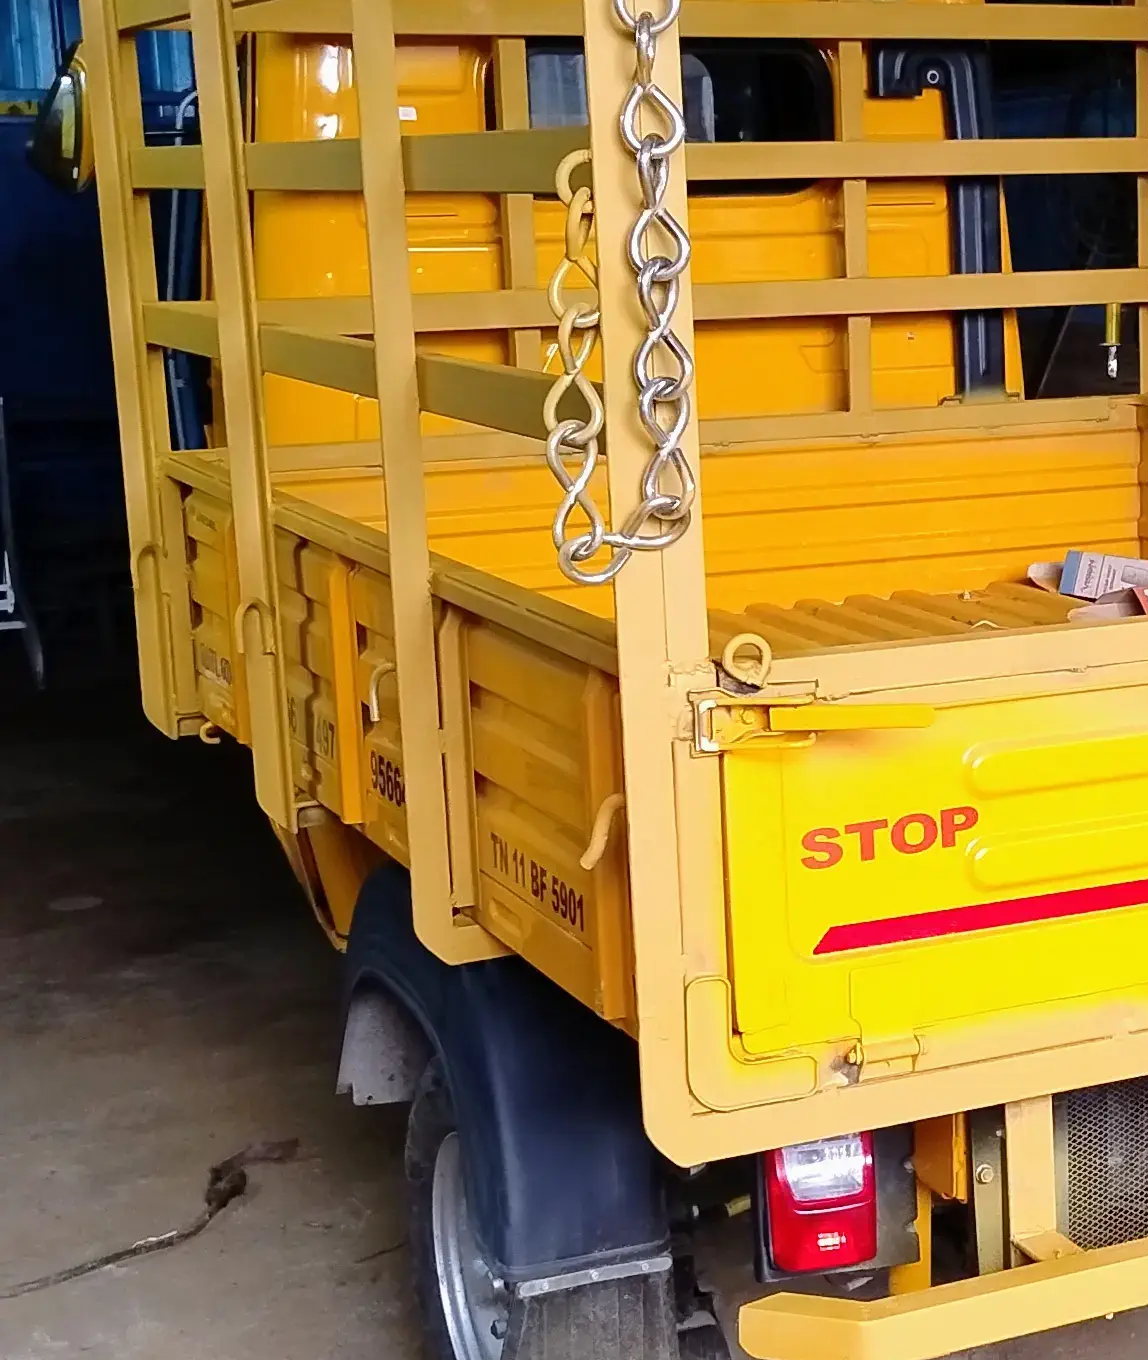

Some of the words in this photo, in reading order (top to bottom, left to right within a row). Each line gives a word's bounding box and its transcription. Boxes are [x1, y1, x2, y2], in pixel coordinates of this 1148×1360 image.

[801, 806, 979, 870] STOP
[490, 832, 508, 876] TN
[513, 848, 526, 888] 11
[531, 859, 547, 902] BF
[552, 875, 584, 932] 5901
